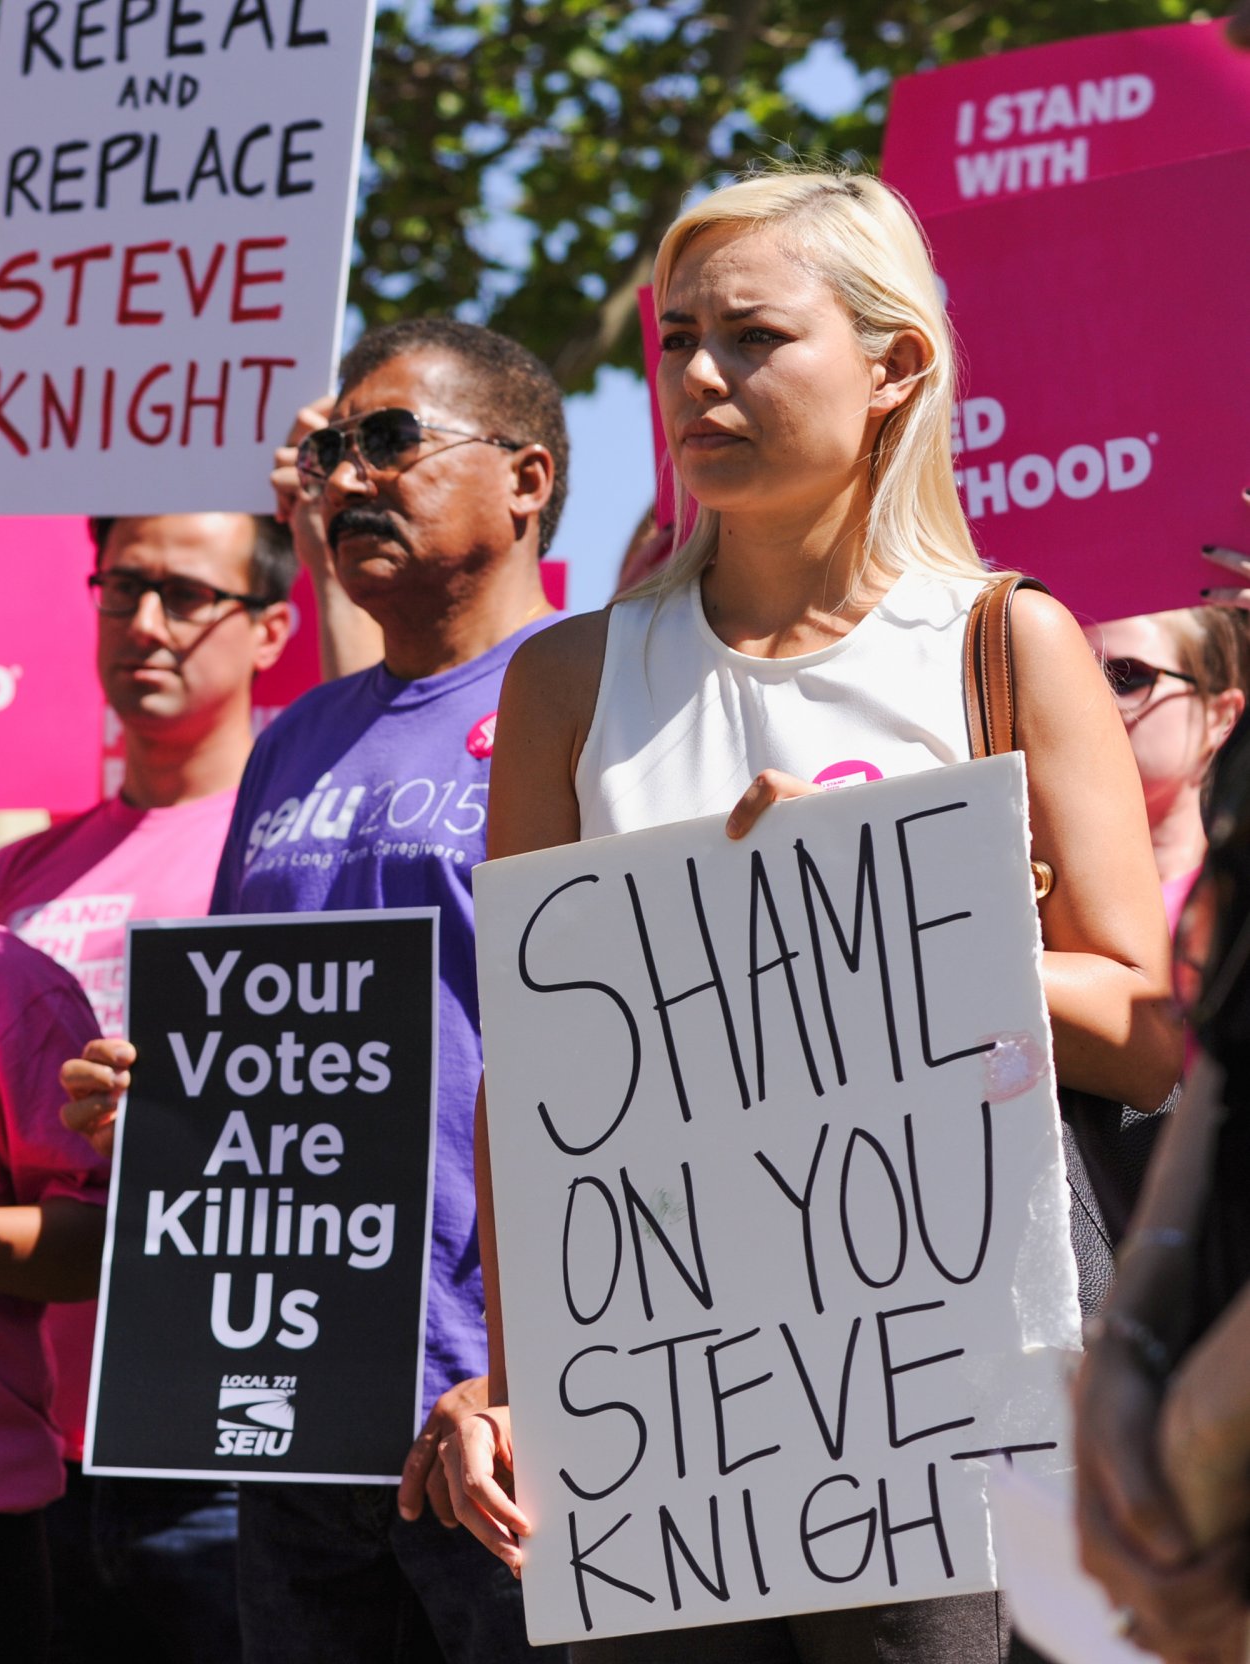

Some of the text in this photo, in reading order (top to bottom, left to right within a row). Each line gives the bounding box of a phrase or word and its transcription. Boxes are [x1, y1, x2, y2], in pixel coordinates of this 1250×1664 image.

[21, 0, 330, 76] REPEAL
[117, 72, 200, 109] AND
[956, 74, 1154, 145] I STAND
[4, 119, 323, 218] REPLACE
[956, 138, 1088, 199] WITH
[358, 777, 490, 836] 2015
[290, 849, 334, 870] Long
[372, 838, 466, 864] Caregivers
[186, 950, 374, 1016] Your
[518, 801, 998, 1156] SHAME
[167, 1031, 391, 1097] Votes
[202, 1110, 344, 1177] Are
[143, 1187, 396, 1270] Killing
[562, 1101, 993, 1326] ON YOU
[210, 1272, 319, 1350] Us
[220, 1374, 298, 1389] LOCAL 721
[558, 1300, 976, 1502] STEVE
[214, 1431, 293, 1457] SEIU
